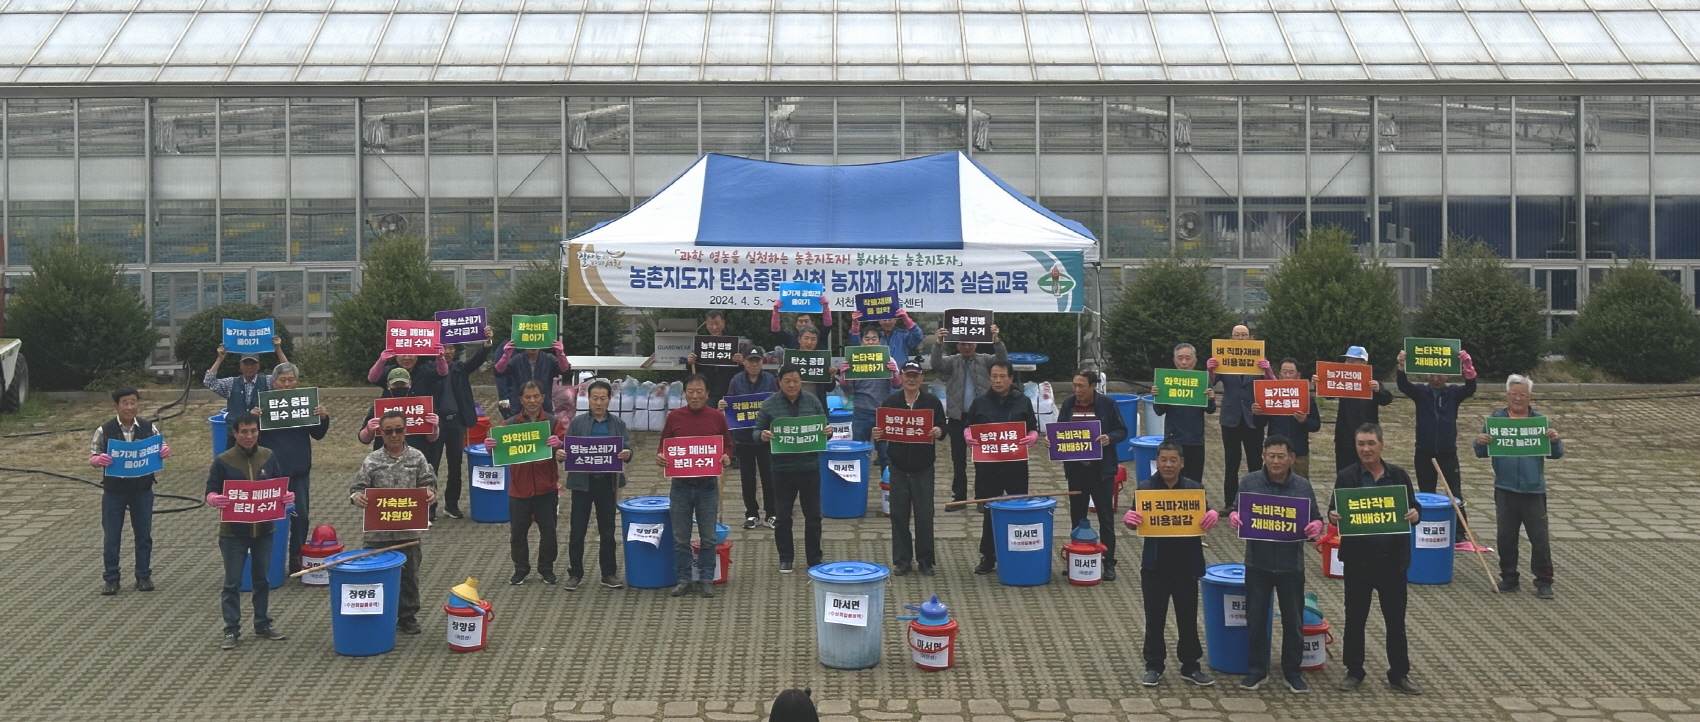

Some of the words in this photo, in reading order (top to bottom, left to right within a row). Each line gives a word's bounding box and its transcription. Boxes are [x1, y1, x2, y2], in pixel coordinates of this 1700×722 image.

[709, 249, 740, 263] 영농을
[745, 251, 789, 265] 실천하는
[795, 251, 850, 265] 농촌지도자!
[856, 253, 899, 266] 봉사하는
[630, 265, 715, 290] 농촌지도자
[831, 270, 882, 292] 농자재
[887, 269, 954, 294] 자가제조
[961, 270, 1028, 294] 실습교육
[782, 289, 800, 297] 농기계
[801, 289, 820, 298] 공회전
[709, 296, 737, 305] 2024.
[740, 297, 750, 305] 4.
[753, 297, 763, 306] 5.
[791, 298, 810, 306] 줄이기
[441, 315, 482, 327] 영농쓰레기
[951, 316, 968, 325] 농약
[970, 316, 985, 325] 빈병
[226, 327, 247, 337] 농기계
[248, 327, 271, 337] 공회전
[390, 327, 407, 337] 영농
[445, 326, 479, 337] 소각금지
[518, 322, 549, 331] 화학비료
[952, 327, 968, 336] 분리
[969, 327, 985, 336] 수거
[236, 337, 259, 346] 줄이기
[395, 338, 412, 348] 분리
[414, 338, 432, 348] 수거
[521, 333, 545, 342] 줄이기
[701, 342, 716, 350] 농약
[717, 342, 732, 350] 빈병
[1216, 346, 1225, 356] 벼
[1226, 346, 1261, 357] 직파재배
[1414, 346, 1451, 356] 논타작물
[700, 351, 715, 359] 분리
[716, 351, 731, 359] 수거
[852, 353, 883, 362] 논타작물
[791, 356, 807, 365] 탄소
[809, 357, 825, 366] 중립
[1222, 357, 1255, 368] 비용절감
[1414, 357, 1451, 367] 재배하기
[808, 367, 824, 376] 실천
[852, 363, 884, 373] 재배하기
[1326, 369, 1362, 380] 늦기전에
[1164, 376, 1199, 387] 화학비료
[1326, 380, 1362, 391] 탄소중립
[1168, 388, 1193, 399] 줄이기
[1264, 387, 1300, 398] 늦기전에
[268, 399, 288, 409] 탄소
[290, 396, 309, 408] 중립
[1265, 398, 1300, 409] 탄소중립
[269, 410, 289, 421] 필수
[290, 407, 310, 420] 실천
[405, 404, 425, 415] 사용
[884, 414, 904, 425] 농약
[905, 416, 925, 426] 사용
[773, 425, 782, 434] 벼
[783, 424, 799, 434] 중간
[885, 425, 904, 436] 안전
[905, 426, 924, 437] 준수
[1056, 429, 1091, 440] 녹비작물
[1489, 427, 1499, 436] 벼
[1500, 427, 1518, 436] 중간
[502, 430, 541, 444] 화학비료
[778, 435, 795, 445] 기간
[796, 434, 819, 444] 늘리기
[980, 432, 997, 441] 농약
[999, 430, 1018, 440] 사용
[981, 443, 999, 453] 안전
[1000, 442, 1019, 453] 준수
[1057, 441, 1092, 452] 재배하기
[1496, 438, 1514, 447] 기간
[1516, 438, 1541, 447] 늘리기
[111, 448, 137, 459] 농기계
[138, 443, 160, 457] 공회전
[508, 443, 536, 456] 줄이기
[570, 444, 617, 454] 영농쓰레기
[667, 446, 686, 456] 영농
[124, 458, 149, 469] 줄이기
[575, 455, 612, 465] 소각금지
[674, 458, 693, 468] 분리
[695, 457, 714, 468] 수거
[227, 488, 249, 500] 영농
[233, 502, 254, 514] 분리
[257, 500, 277, 513] 수거
[376, 497, 418, 508] 가축분뇨
[1141, 500, 1151, 511] 벼
[1155, 500, 1200, 511] 직파재배
[1348, 497, 1395, 510] 논타작물
[380, 510, 413, 521] 자원화
[1251, 503, 1297, 519] 녹비작물
[1150, 514, 1194, 526] 비용절감
[1350, 512, 1397, 525] 재배하기
[1250, 518, 1297, 533] 재배하기
[1422, 526, 1446, 535] 판교면
[1014, 529, 1037, 538] 마서면
[1074, 558, 1097, 567] 마서면
[349, 589, 376, 599] 장항읍
[833, 598, 860, 610] 마서면
[451, 620, 476, 632] 장항읍
[917, 638, 942, 650] 마서면
